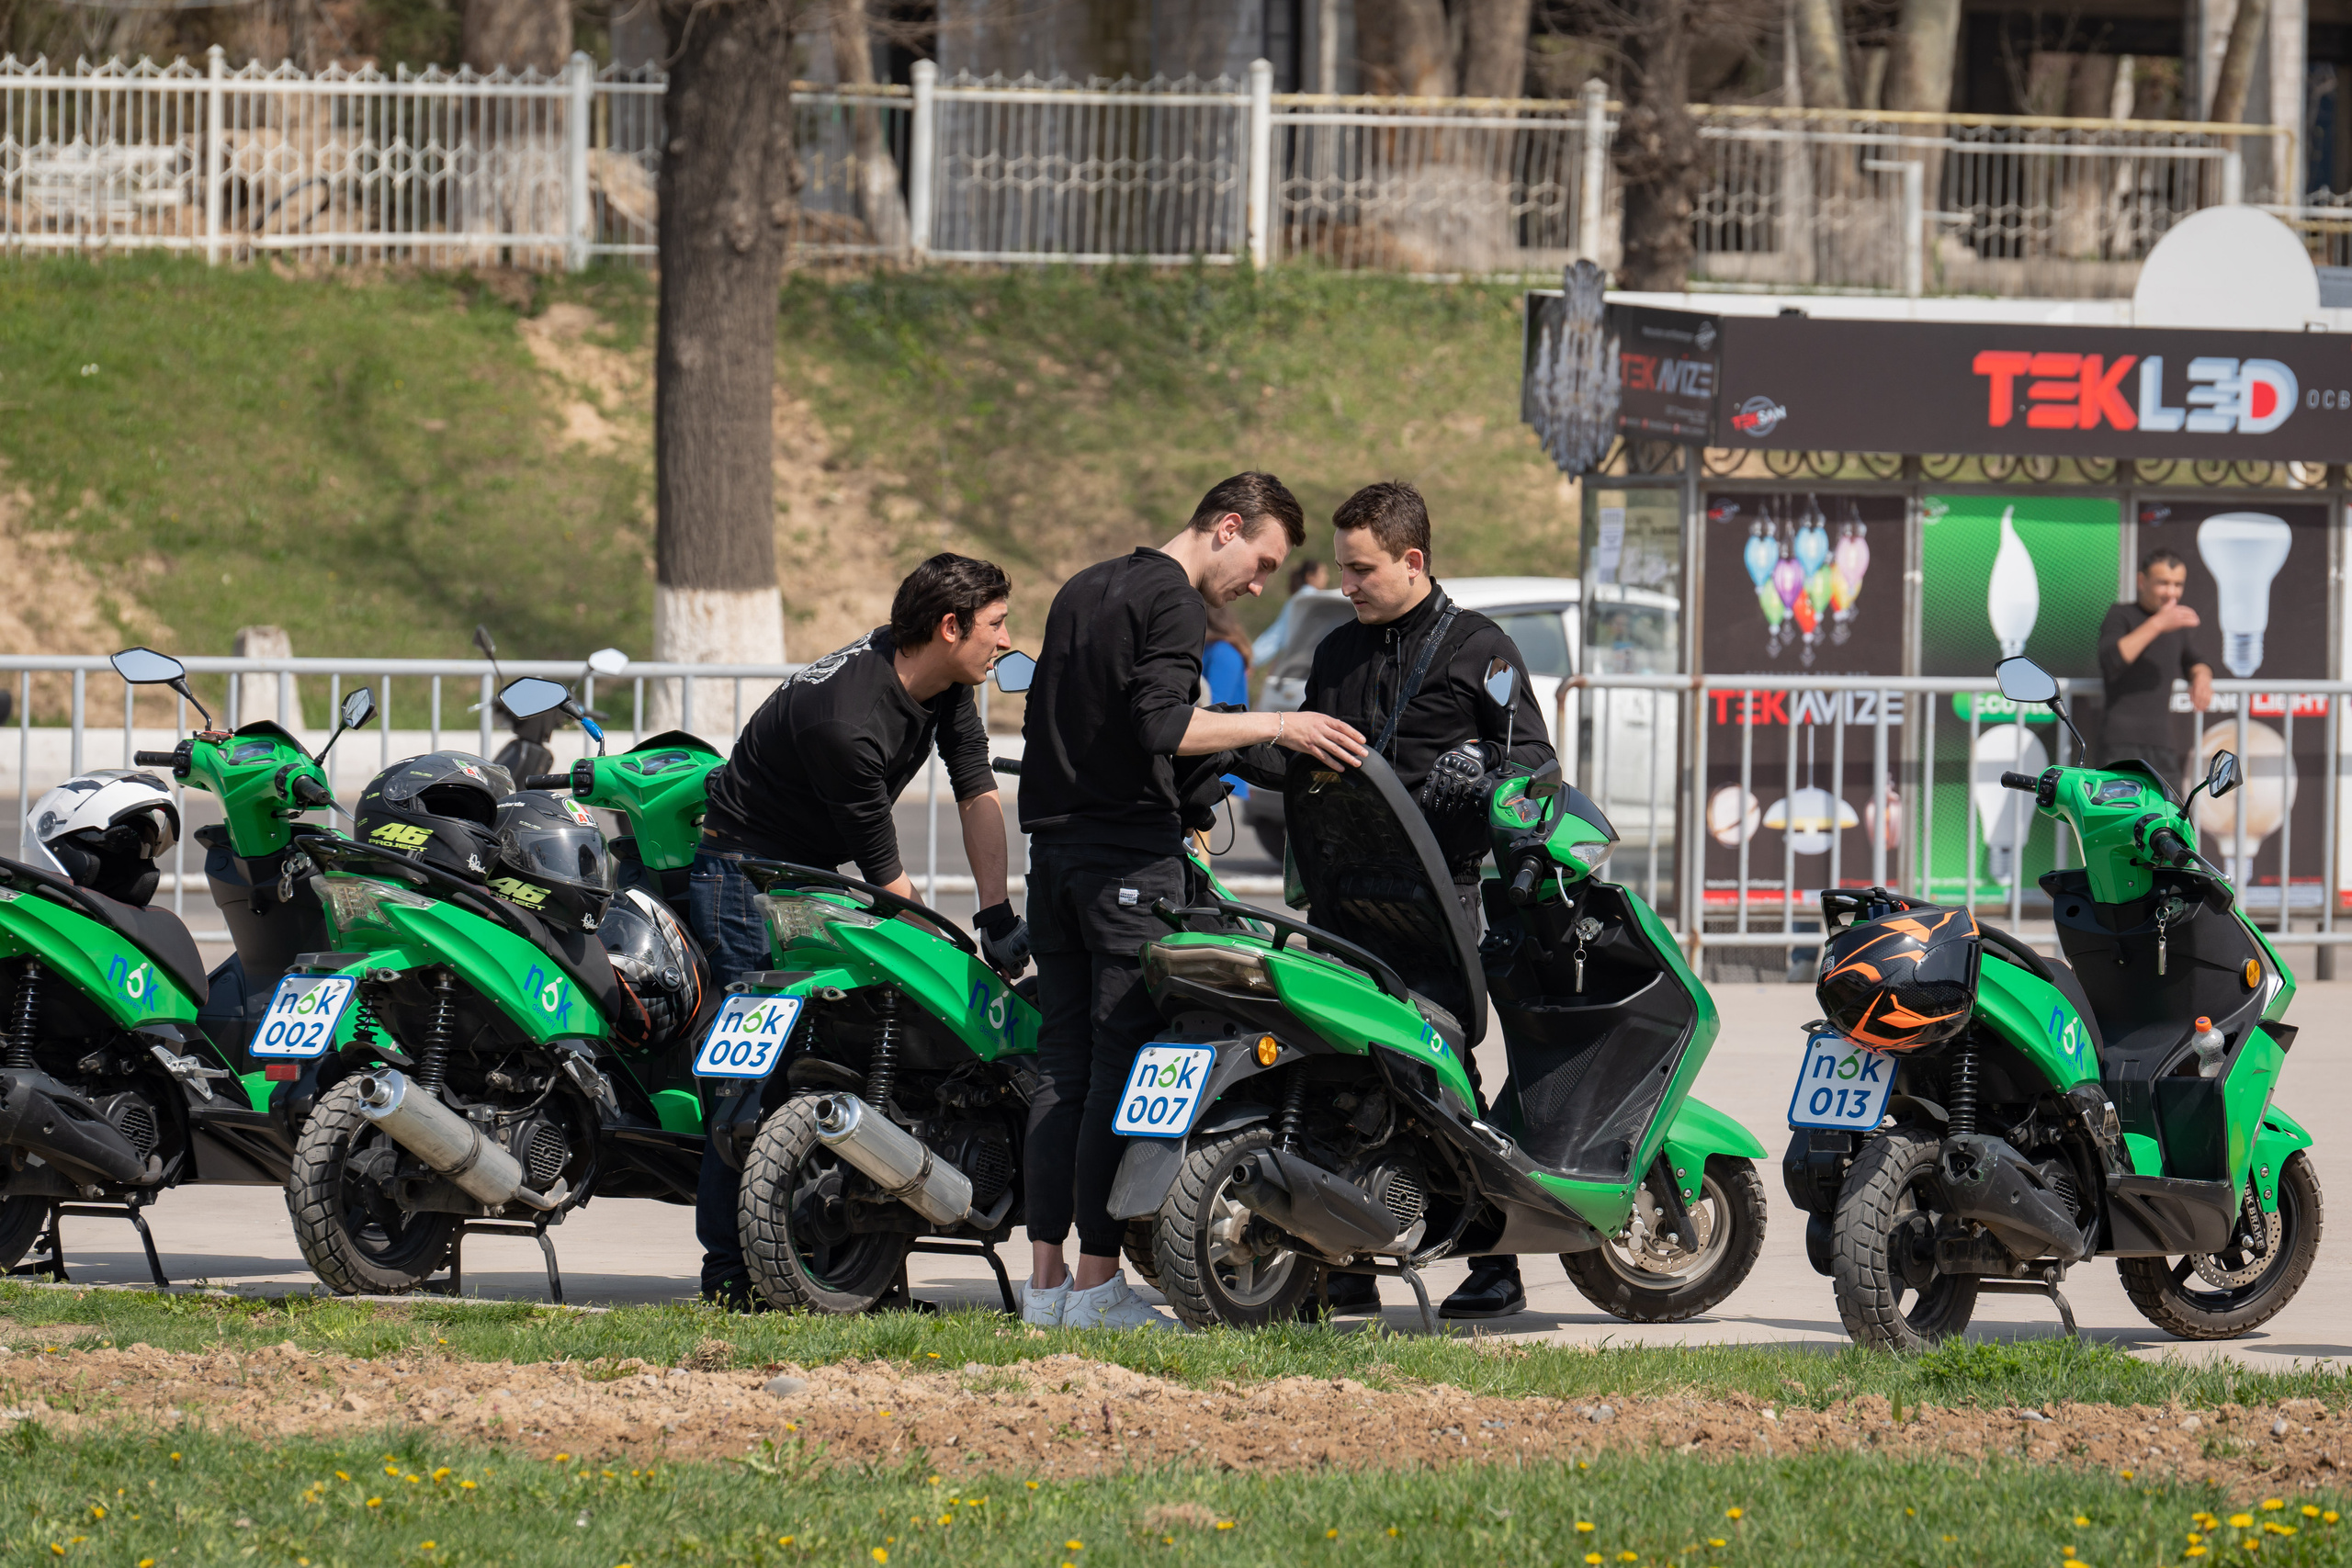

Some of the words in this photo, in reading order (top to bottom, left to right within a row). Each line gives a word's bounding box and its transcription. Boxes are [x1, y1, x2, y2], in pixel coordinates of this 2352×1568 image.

[1973, 350, 2300, 434] TEKLED
[368, 838, 428, 852] PROJECT
[369, 822, 434, 846] 46
[486, 876, 551, 904] 46
[490, 890, 546, 911] ROJECT
[107, 953, 159, 1012] nok
[523, 964, 573, 1030] nok
[118, 991, 143, 1015] delivery
[277, 986, 338, 1015] nok
[968, 978, 1020, 1048] nok
[532, 1002, 557, 1030] delivery
[720, 1004, 786, 1035] nok
[265, 1021, 324, 1048] 002
[2048, 1005, 2086, 1072] nok
[708, 1040, 774, 1067] 003
[1812, 1048, 1885, 1083] nok
[2055, 1046, 2076, 1073] delivery
[1136, 1055, 1199, 1089] nok
[1126, 1095, 1189, 1125] 007
[1809, 1087, 1871, 1119] 013
[2244, 1181, 2254, 1206] ISK
[2249, 1207, 2266, 1250] BRAKE
